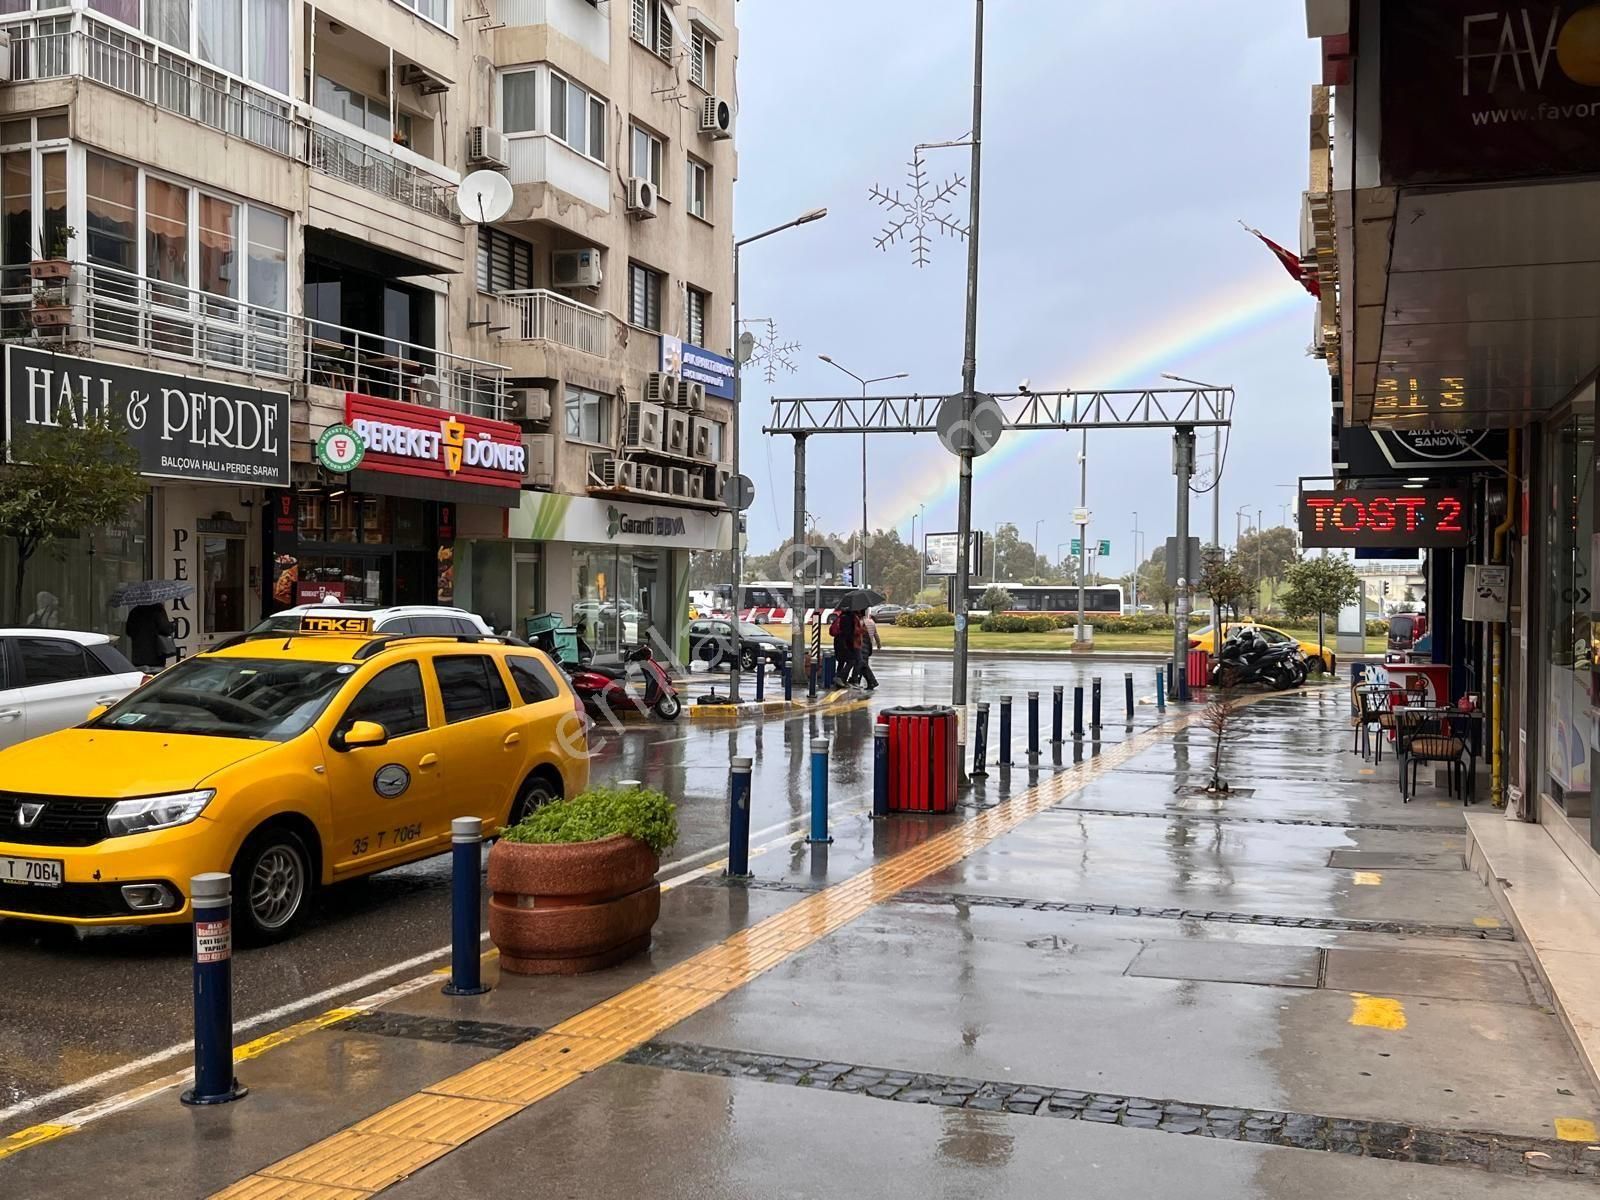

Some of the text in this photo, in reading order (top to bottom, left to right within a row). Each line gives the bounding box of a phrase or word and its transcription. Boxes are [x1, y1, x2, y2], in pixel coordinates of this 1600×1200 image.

[25, 366, 279, 457] HALI & PERDE
[353, 418, 525, 472] BEREKET DÖNER
[161, 456, 201, 471] BALÇOVA
[202, 459, 220, 472] HALI
[226, 462, 252, 475] PERDE
[252, 465, 279, 478] SARAYI
[620, 513, 654, 535] Garanti
[1306, 497, 1462, 533] TOST 2
[352, 822, 422, 856] 35 T 7064
[8, 860, 60, 882] T 7064
